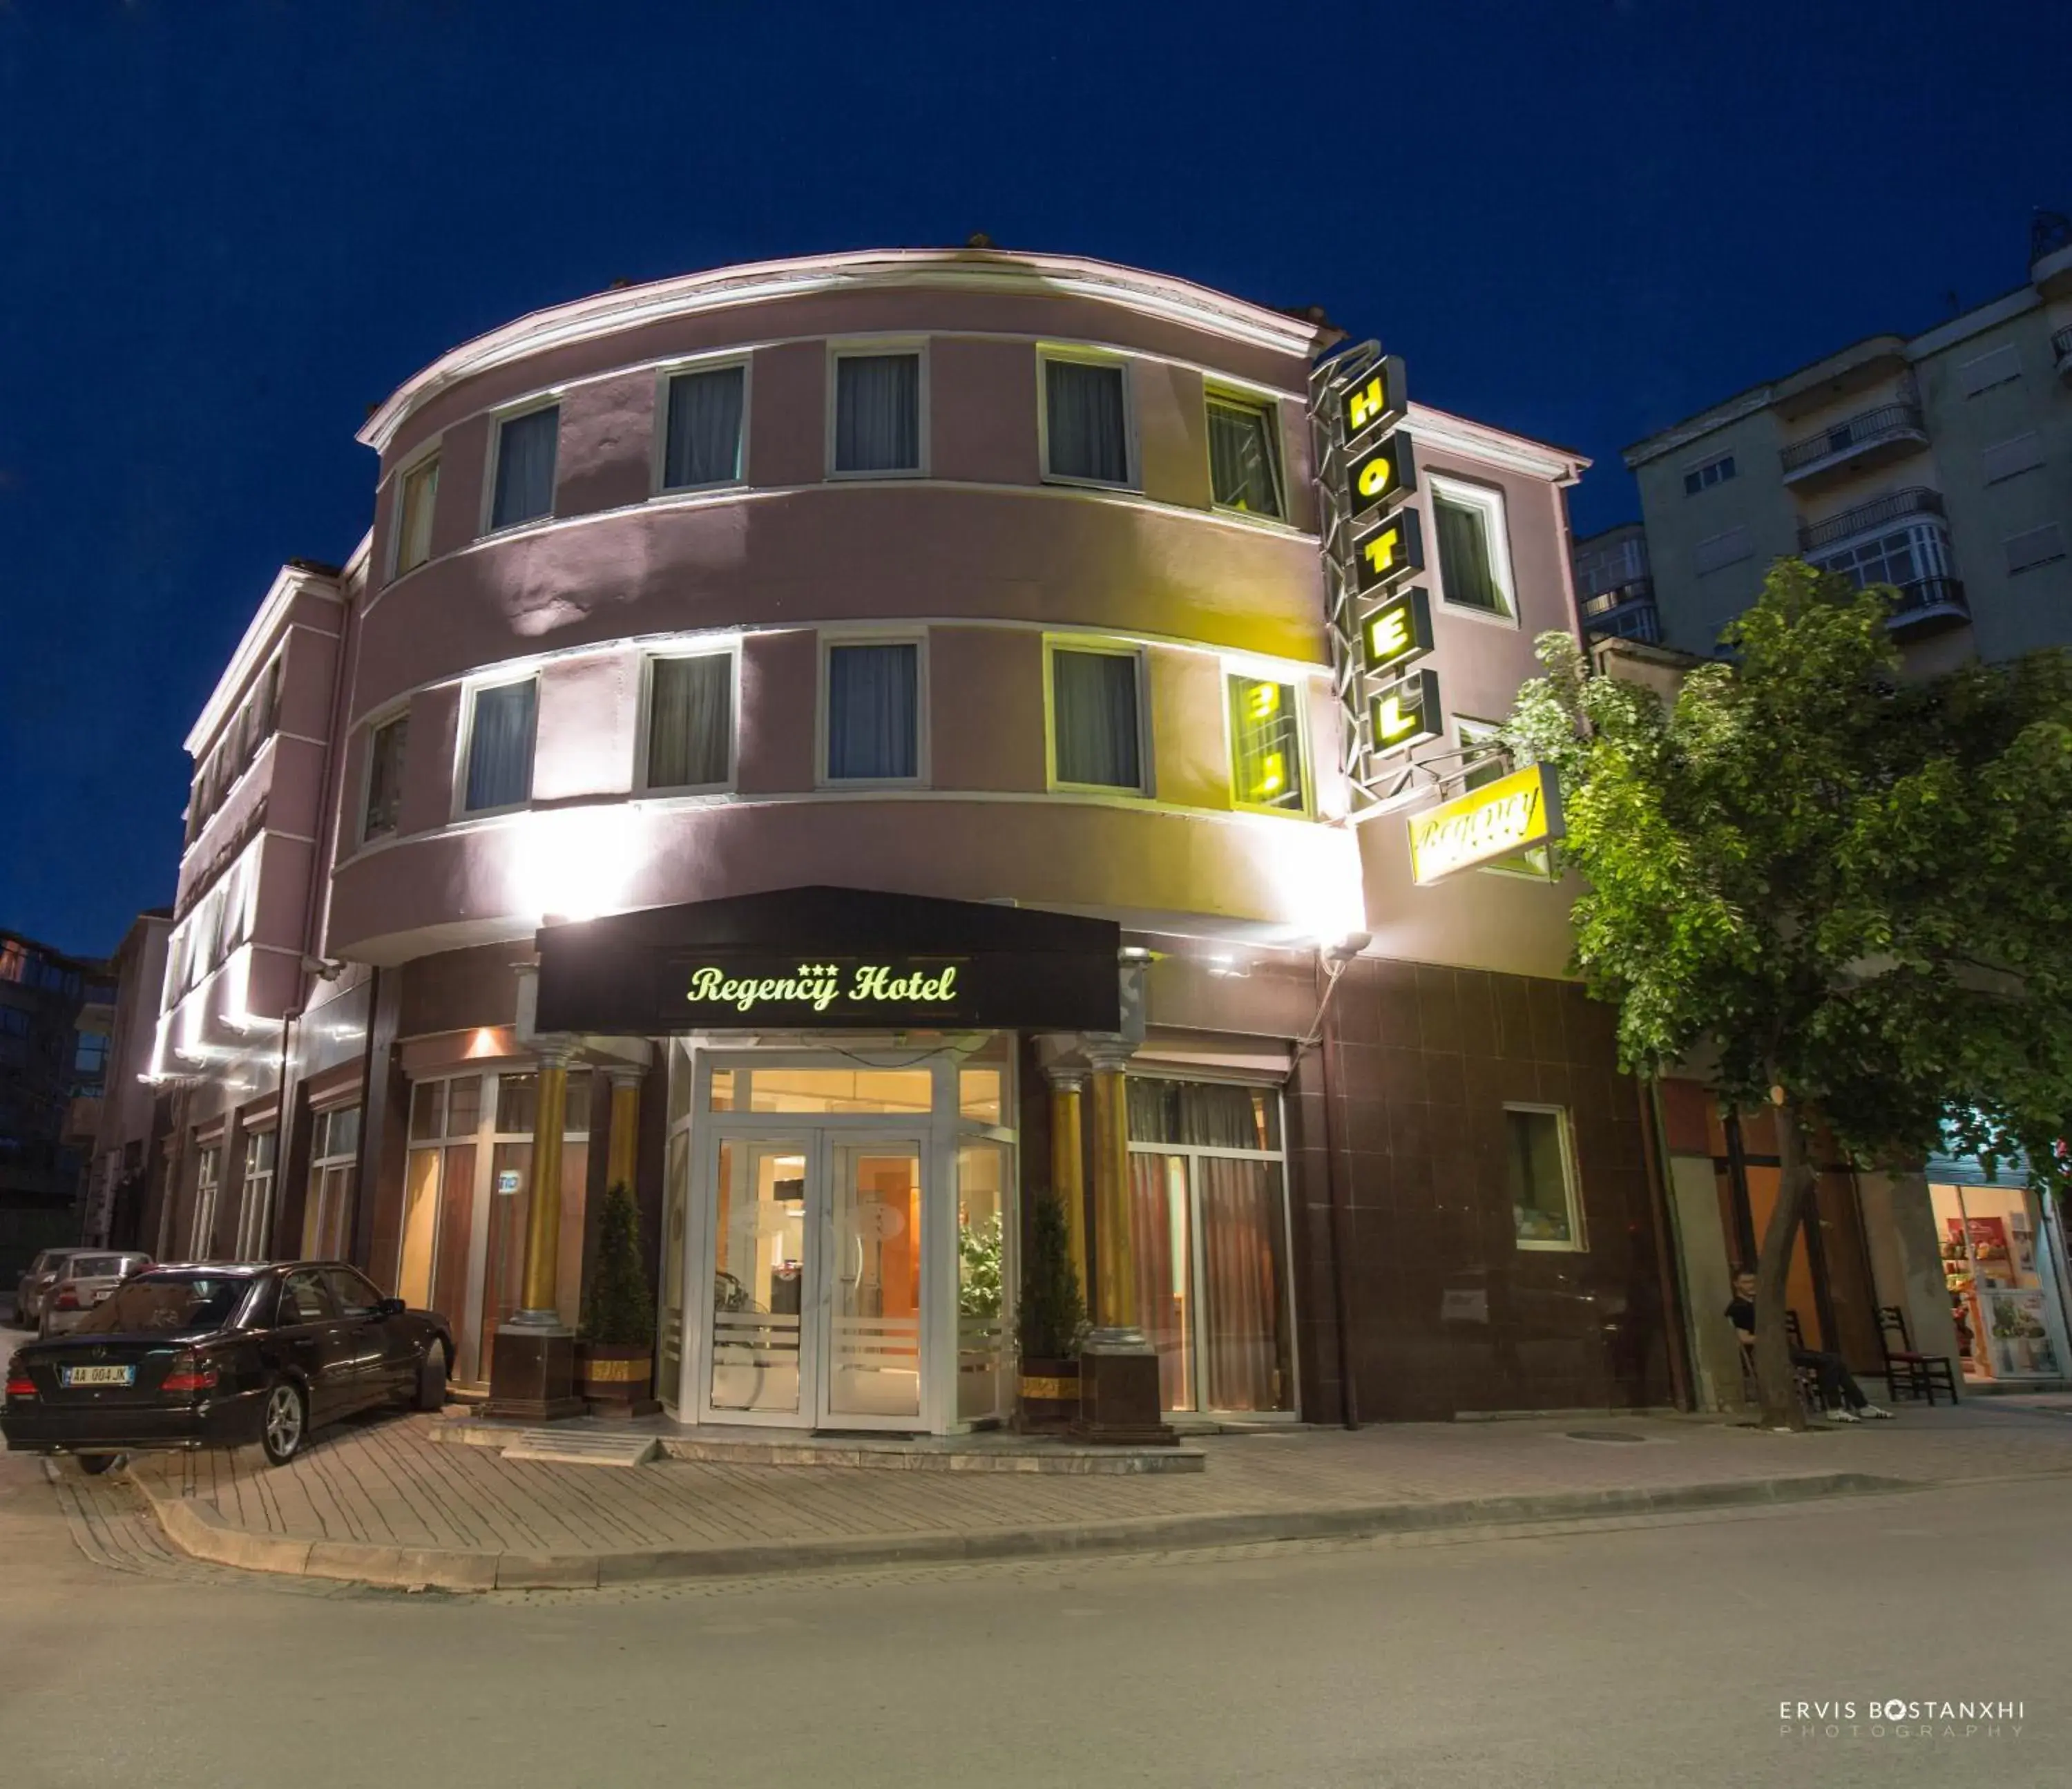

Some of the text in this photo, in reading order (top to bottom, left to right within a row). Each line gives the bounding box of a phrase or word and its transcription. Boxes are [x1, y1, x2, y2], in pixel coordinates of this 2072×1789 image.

[1350, 377, 1416, 739] HOTEL
[687, 966, 957, 1011] Regency Hotel
